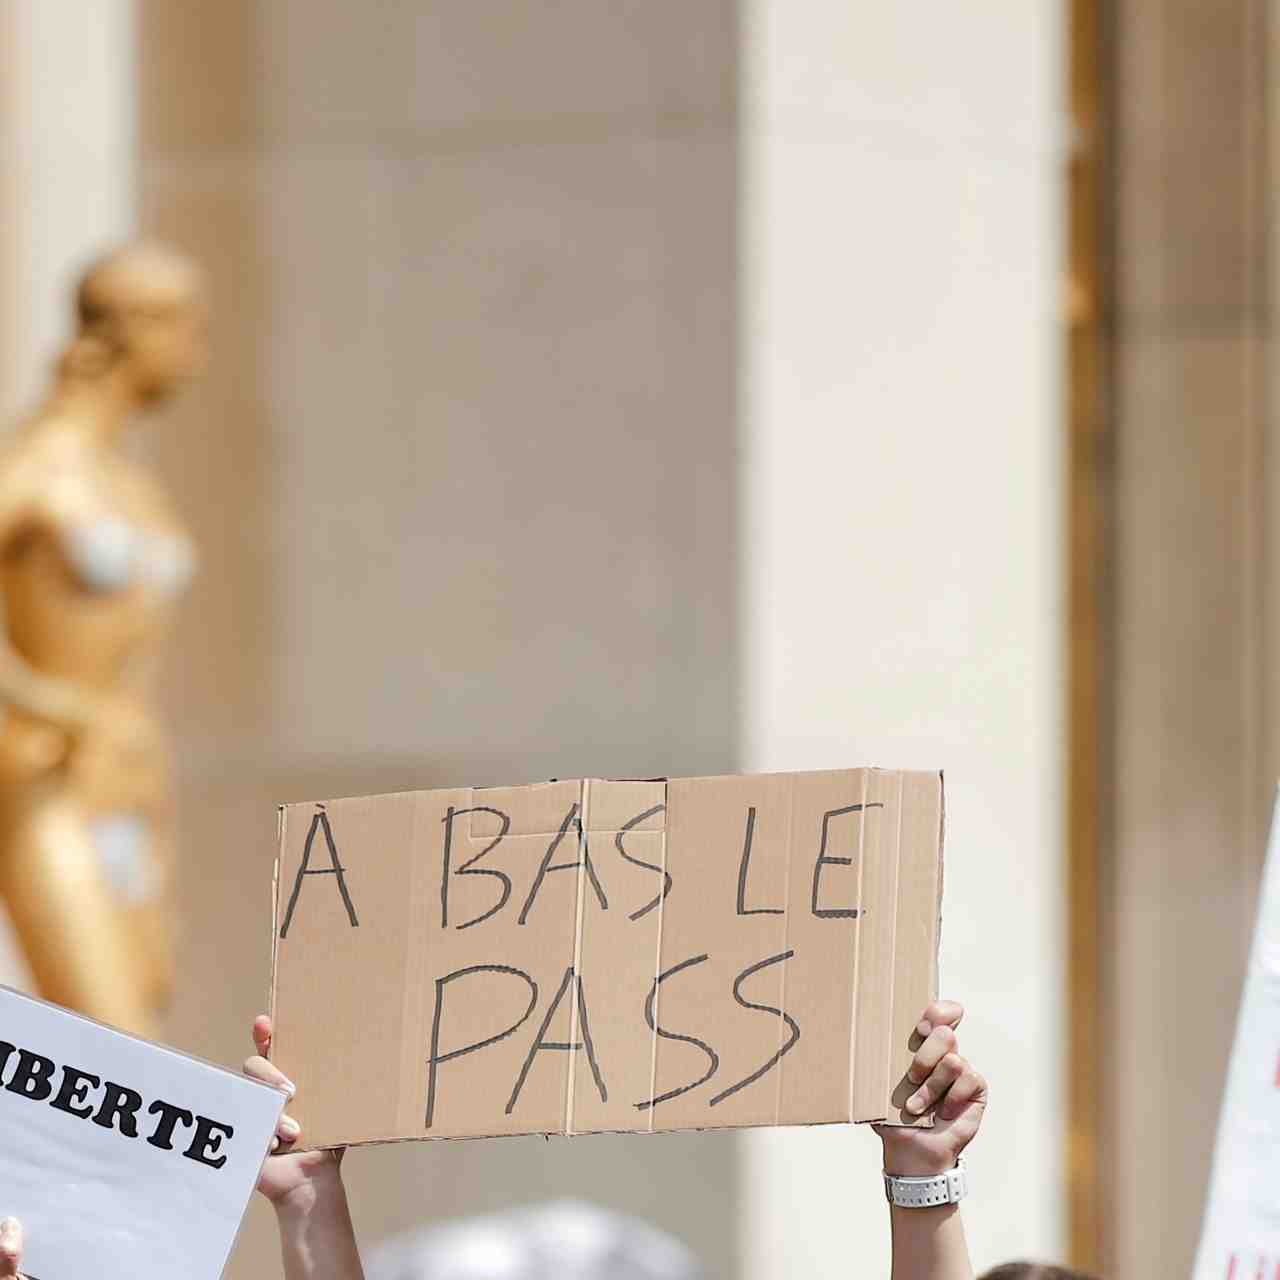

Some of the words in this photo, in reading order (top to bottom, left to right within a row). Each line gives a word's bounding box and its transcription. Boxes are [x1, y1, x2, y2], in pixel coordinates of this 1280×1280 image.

[440, 803, 674, 931] BAS
[735, 804, 884, 919] LE
[425, 950, 802, 1129] PASS
